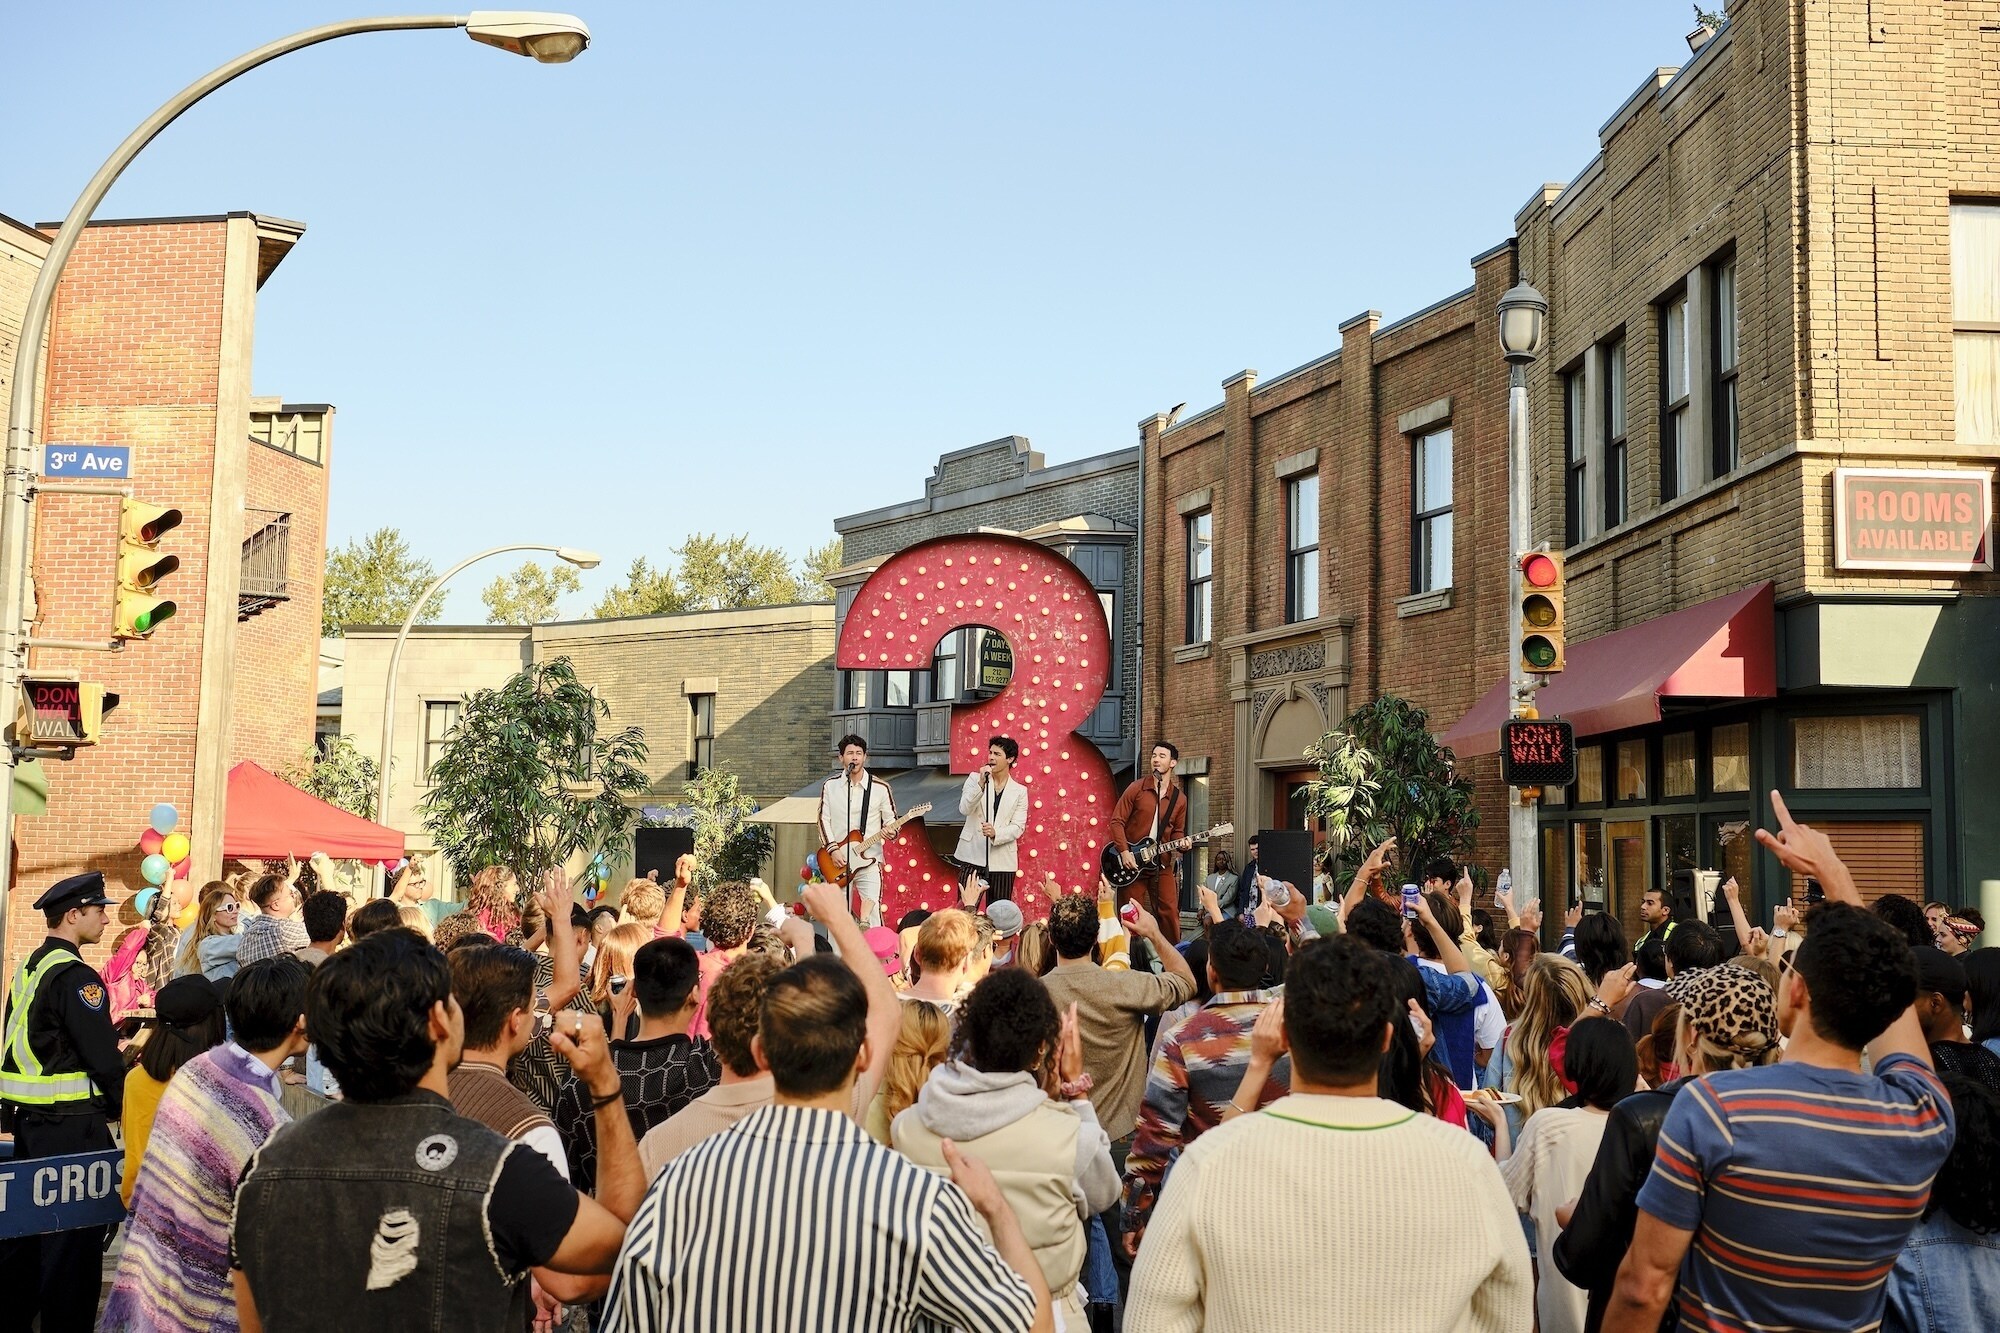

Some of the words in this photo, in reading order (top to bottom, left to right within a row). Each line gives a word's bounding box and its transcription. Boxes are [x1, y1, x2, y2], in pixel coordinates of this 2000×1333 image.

[50, 451, 78, 470] 3rd
[81, 452, 123, 472] Ave
[1855, 490, 1974, 524] ROOMS
[1856, 527, 1975, 552] AVAILABLE
[985, 638, 991, 648] 7
[983, 651, 990, 661] A
[990, 651, 1012, 662] WEEK
[992, 668, 1002, 676] 212
[36, 687, 80, 704] DON
[36, 703, 82, 720] WAL
[35, 720, 81, 737] WAL
[1511, 744, 1566, 764] WALK
